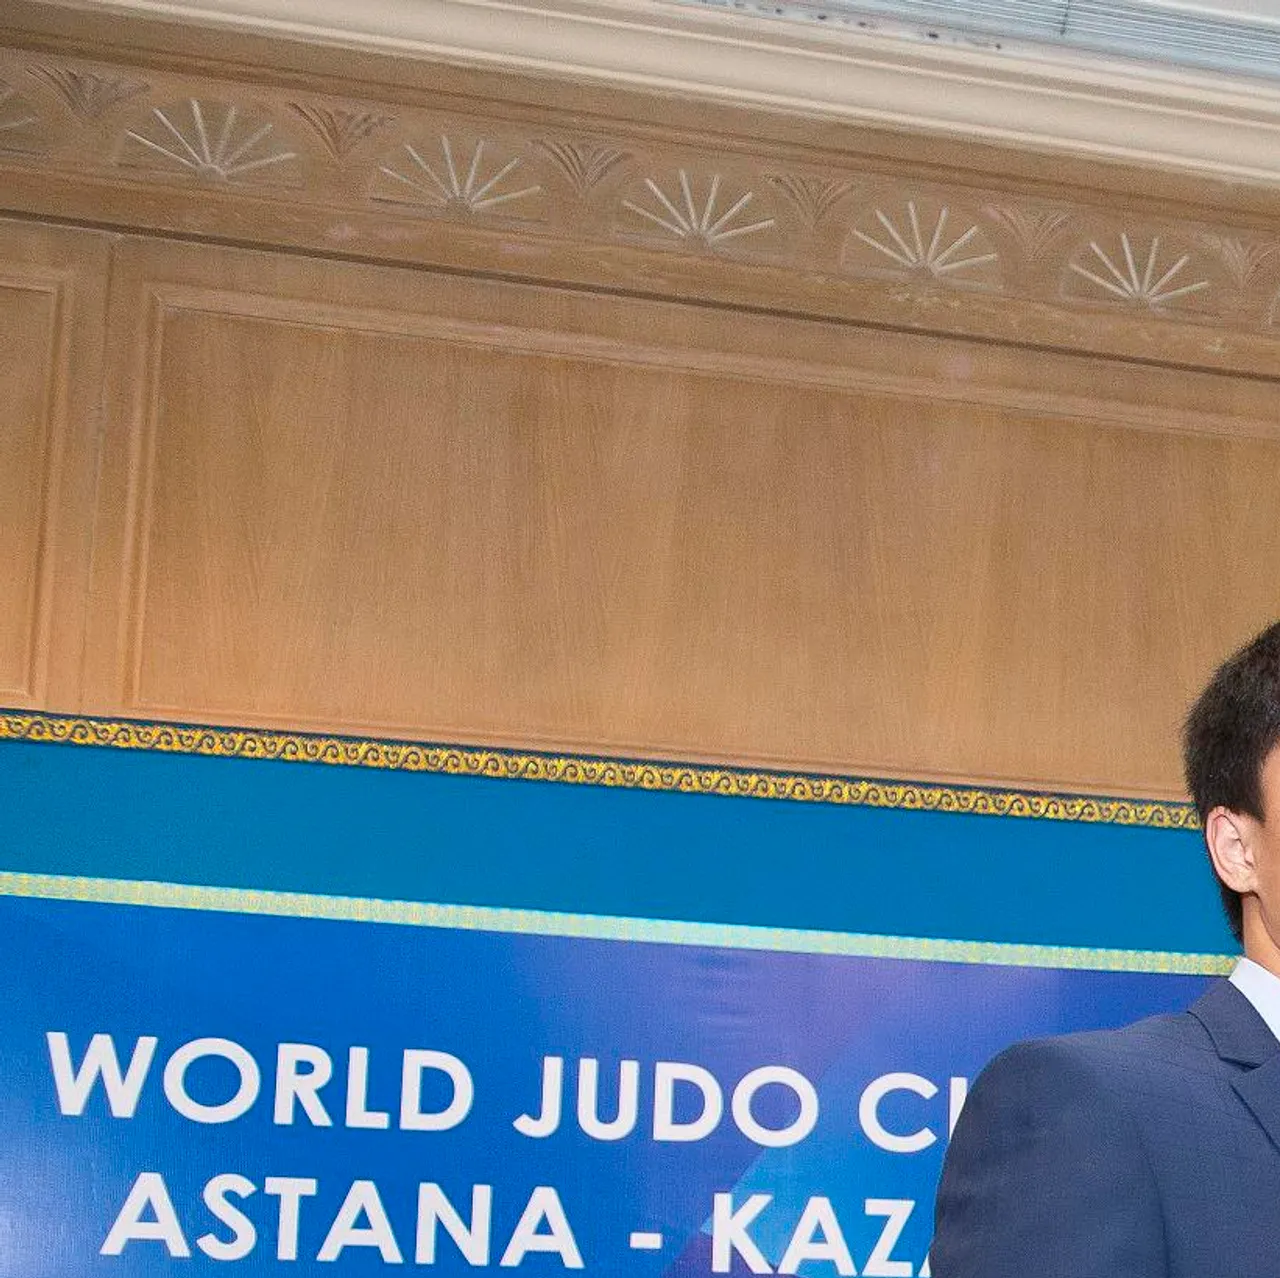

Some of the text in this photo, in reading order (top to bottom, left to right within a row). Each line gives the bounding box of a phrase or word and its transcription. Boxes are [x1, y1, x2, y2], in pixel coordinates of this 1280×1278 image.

[47, 1031, 474, 1131] WORLD
[513, 1056, 819, 1147] JUDO
[100, 1172, 584, 1269] ASTANA
[711, 1192, 932, 1278] KAZ
